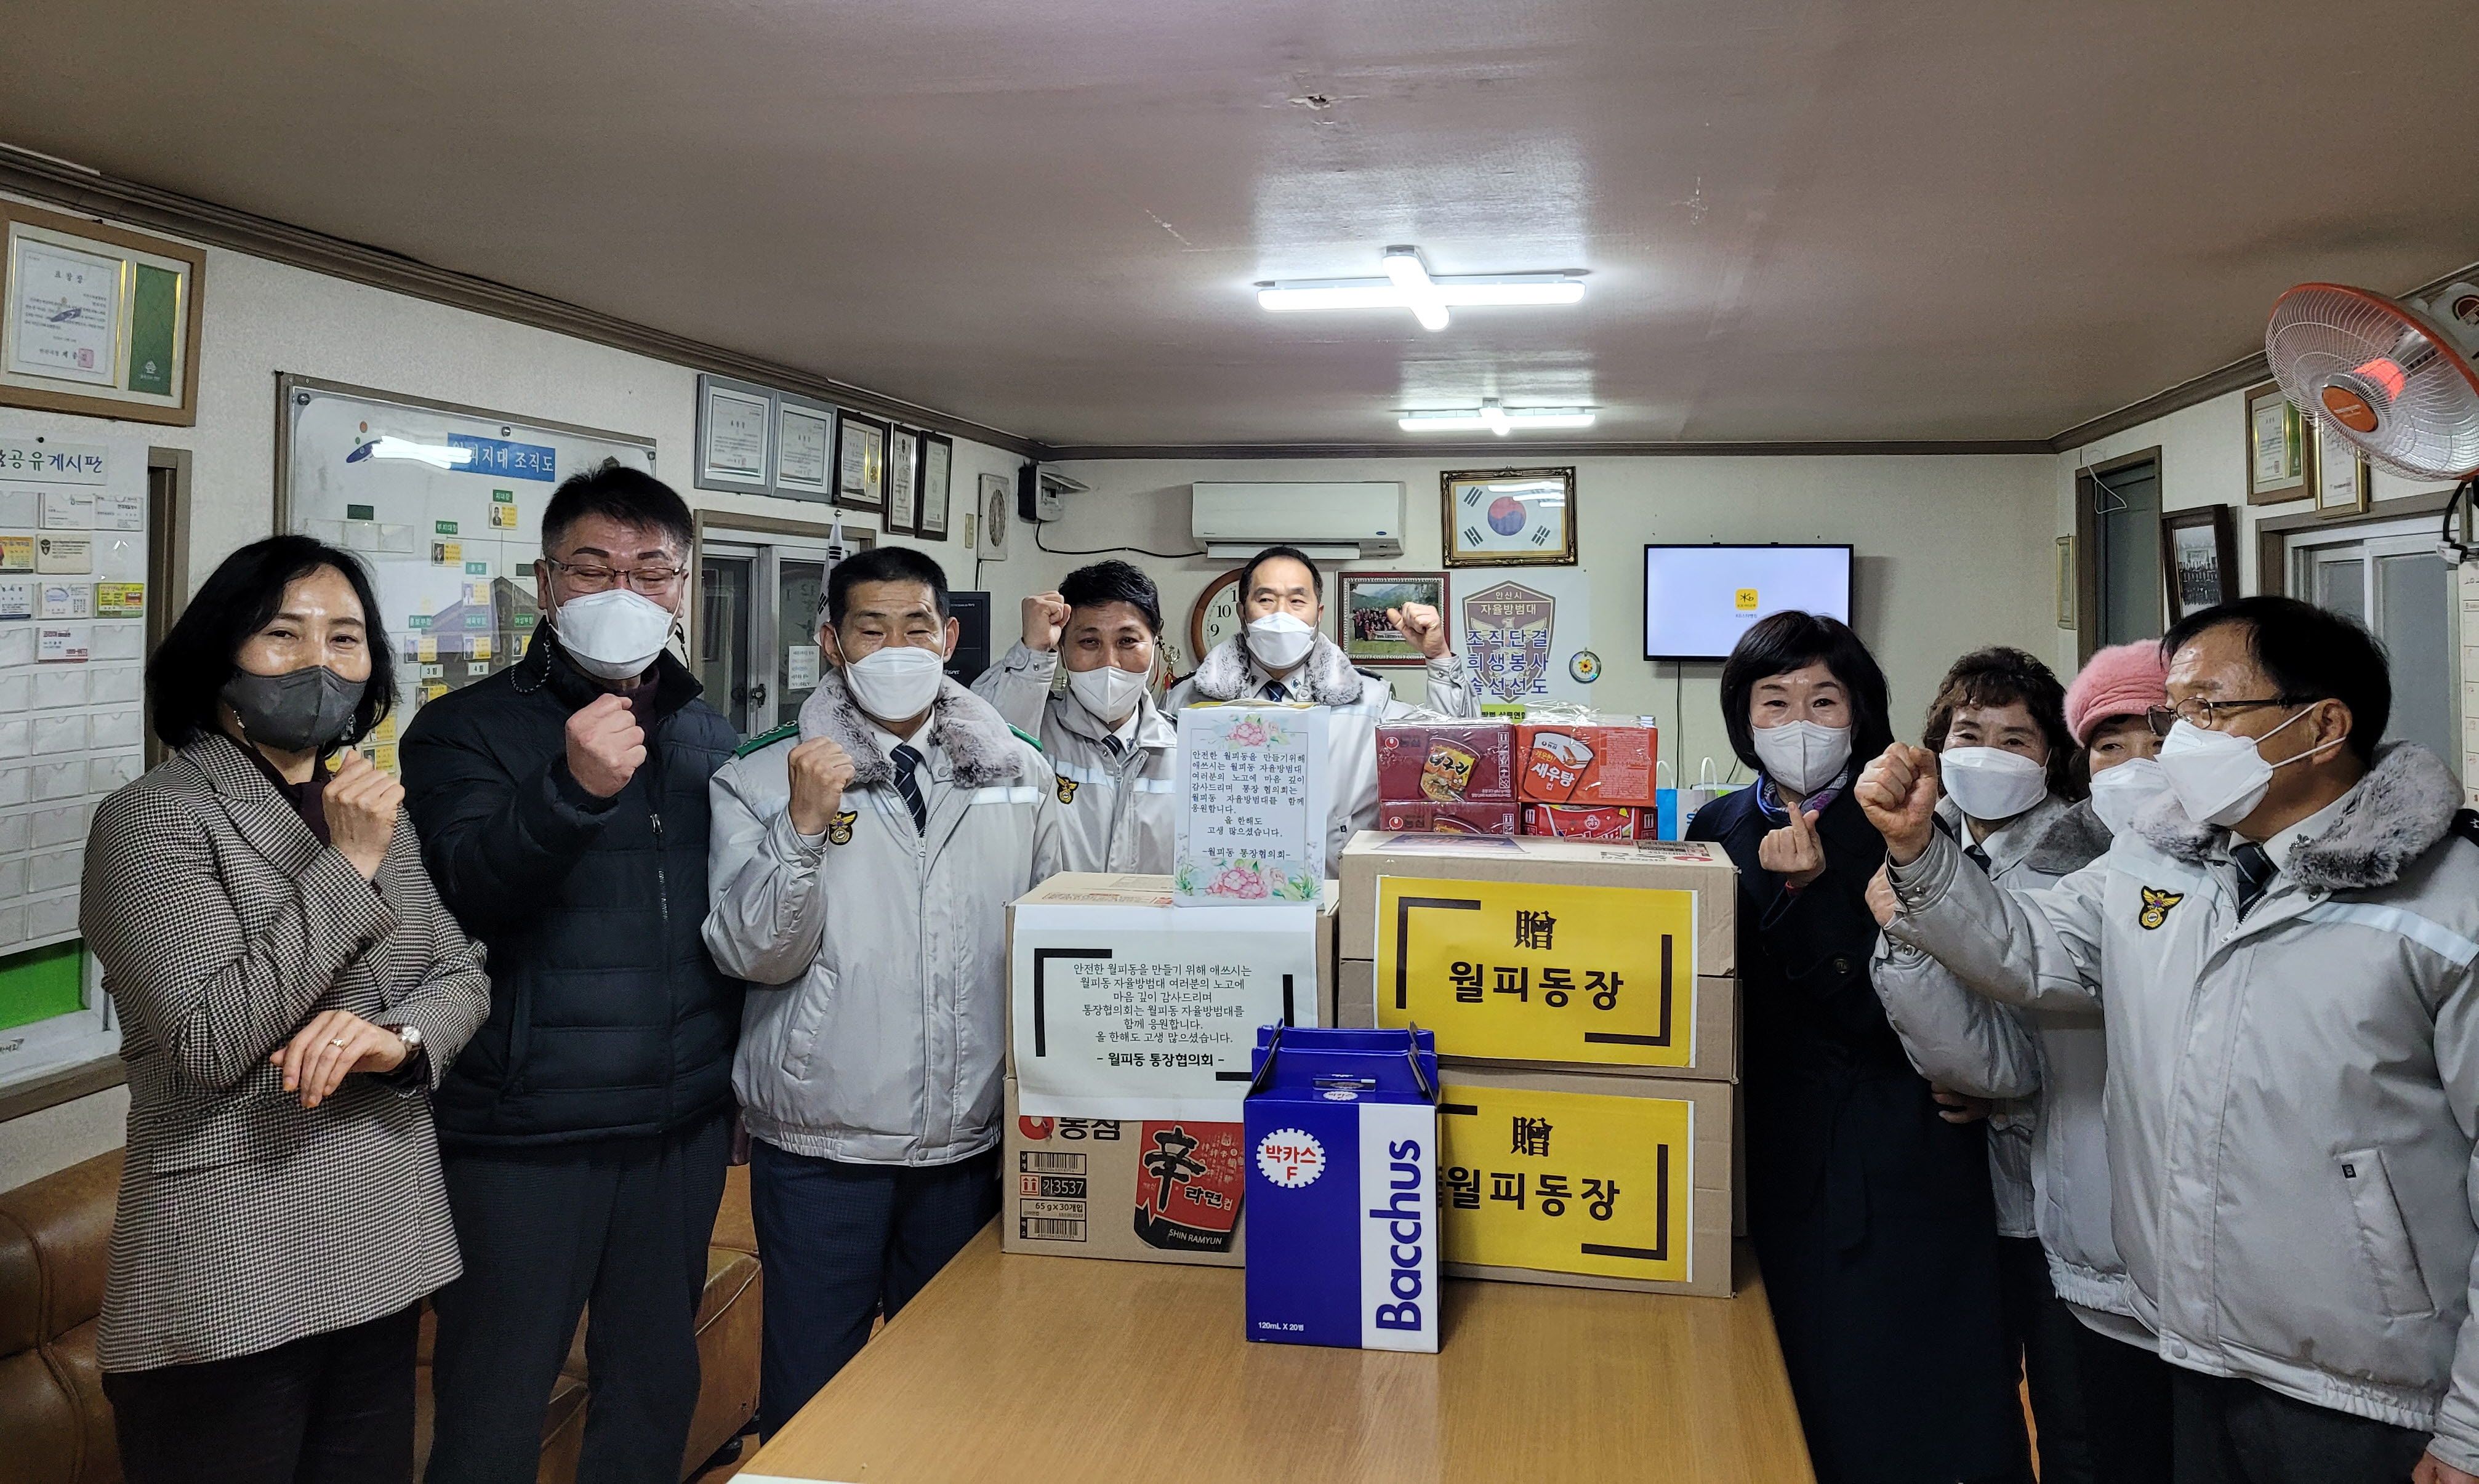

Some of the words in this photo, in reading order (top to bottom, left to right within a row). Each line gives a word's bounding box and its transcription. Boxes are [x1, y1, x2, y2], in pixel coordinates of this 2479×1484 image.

[514, 451, 554, 473] 조직도
[1495, 591, 1523, 600] 안산시
[1216, 604, 1232, 618] 10
[1480, 603, 1537, 616] 자율방범대
[1210, 624, 1219, 637] 9
[1466, 628, 1548, 648] 조직단결
[1466, 653, 1549, 673] 희생봉사
[1192, 751, 1218, 761] 안전한
[1192, 761, 1226, 771] 애쓰시는
[1230, 761, 1256, 772] 월피동
[1260, 763, 1302, 774] 자율방범대
[1530, 761, 1575, 788] 새우탕
[1192, 772, 1225, 782] 여러분의
[1232, 773, 1257, 783] 노고에
[1264, 774, 1282, 784] 마음
[1288, 775, 1305, 785] 깊이
[1191, 782, 1233, 793] 감사드리며
[1242, 784, 1260, 794] 통장
[1264, 785, 1298, 795] 협의회는
[1191, 793, 1216, 803] 월피동
[1226, 794, 1278, 805] 자율방범대를
[1288, 796, 1305, 806] 함께
[1191, 804, 1236, 814] 응원합니다.
[1237, 816, 1263, 826] 한해도
[1207, 826, 1224, 836] 고생
[1229, 826, 1284, 838] 많으셨습니다.
[1514, 910, 1557, 950] 贈
[1073, 963, 1104, 976] 안전한
[1106, 963, 1149, 976] 월피동을
[1152, 963, 1183, 977] 만들기
[1186, 964, 1207, 977] 위해
[1210, 964, 1252, 977] 애쓰시는
[1080, 976, 1111, 990] 월피동
[1114, 976, 1166, 990] 자율방범대
[1169, 977, 1210, 990] 여러분의
[1213, 977, 1245, 990] 노고에
[1448, 961, 1625, 1011] 월피동장
[1113, 991, 1134, 1003] 마음
[1138, 991, 1157, 1004] 깊이
[1160, 991, 1213, 1004] 감사드리며
[1082, 1004, 1144, 1017] 통장협의회는
[1147, 1004, 1179, 1017] 월피동
[1181, 1005, 1245, 1018] 자율방범대를
[1123, 1017, 1145, 1031] 함께
[1148, 1017, 1203, 1031] 응원합니다.
[1095, 1031, 1107, 1044] 올
[1109, 1031, 1141, 1044] 한해도
[1143, 1031, 1164, 1044] 고생
[1168, 1031, 1234, 1045] 많으셨습니다.
[1108, 1053, 1144, 1067] 월피동
[1149, 1053, 1214, 1068] 통장협의회
[1511, 1116, 1554, 1157] 贈
[1266, 1144, 1317, 1165] 박카스
[1144, 1126, 1207, 1212] 辛
[1287, 1166, 1298, 1181] F
[1043, 1178, 1084, 1195] 가3537
[1445, 1166, 1621, 1221] 월피동장
[1184, 1185, 1223, 1208] 라면
[1168, 1229, 1187, 1240] SHIN
[1188, 1233, 1223, 1245] RAMYUN
[1369, 1139, 1423, 1331] Bacchus
[1258, 1322, 1282, 1330] 120mL
